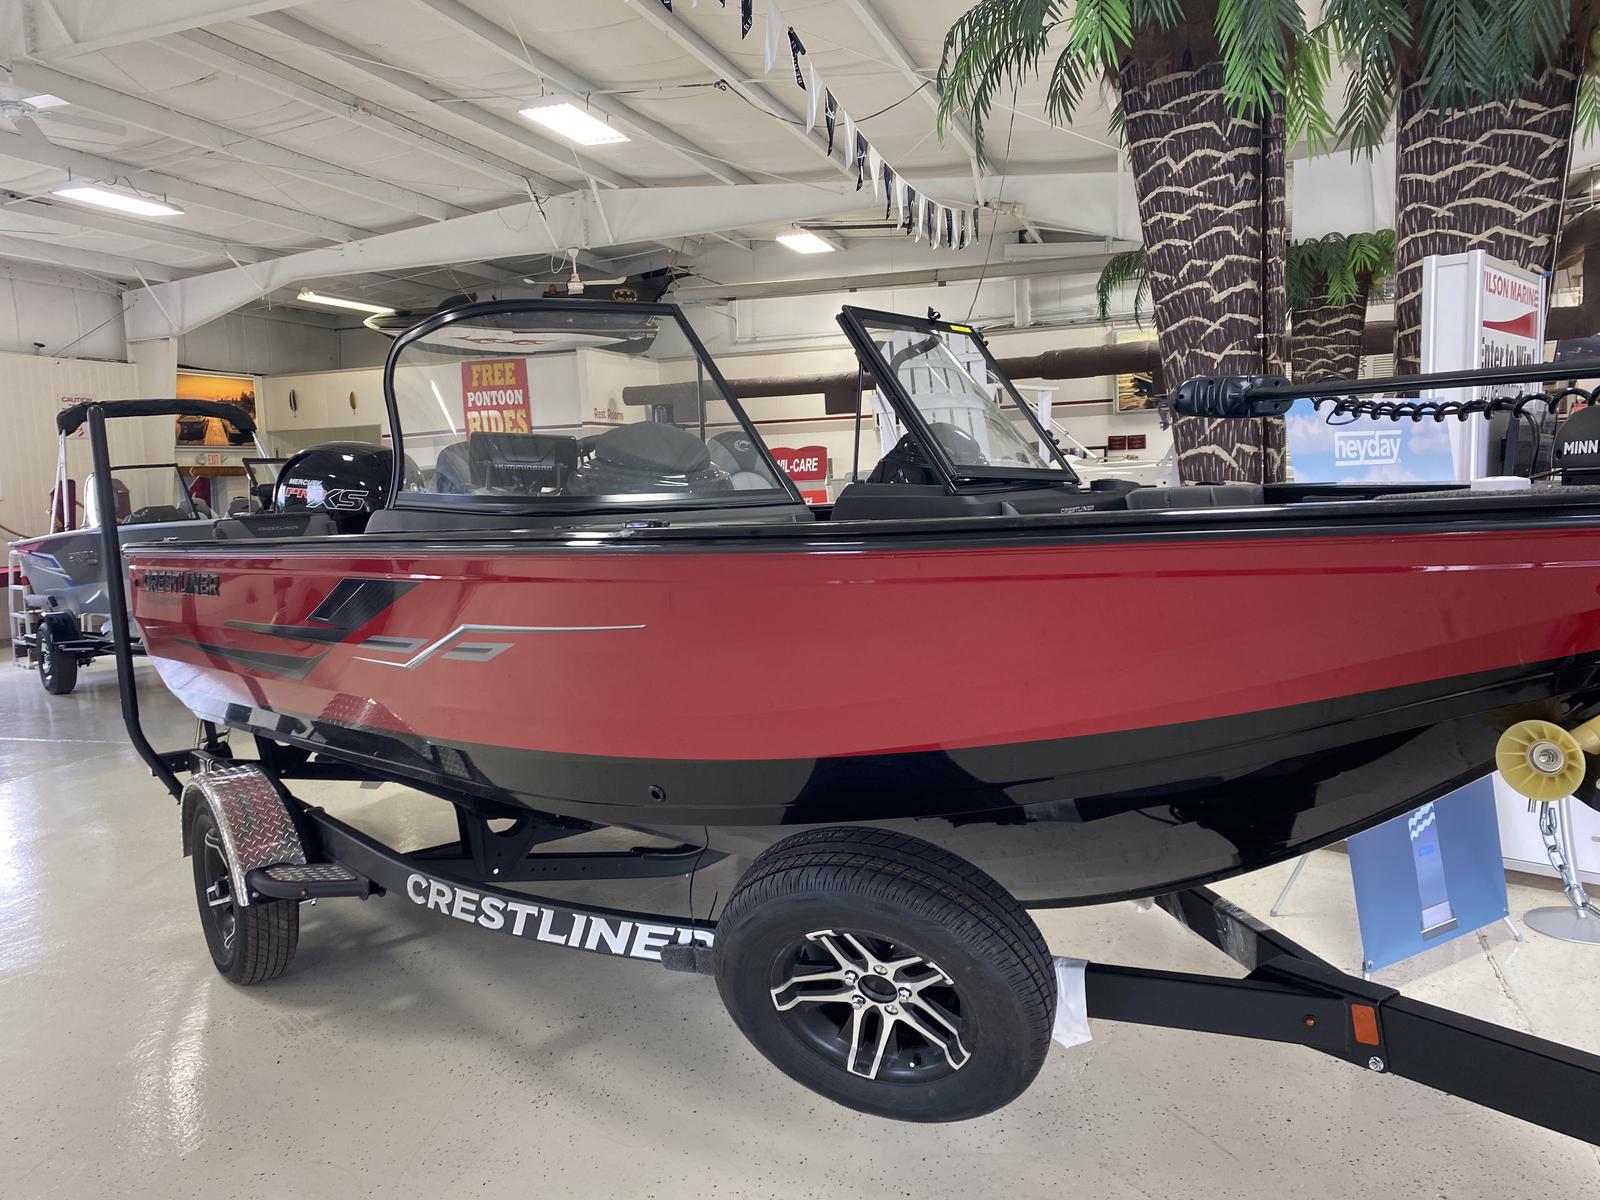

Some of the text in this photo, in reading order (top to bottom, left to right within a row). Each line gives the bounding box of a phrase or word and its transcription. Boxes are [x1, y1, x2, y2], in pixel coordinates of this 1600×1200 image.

[1484, 270, 1538, 308] ILSON MARINE
[1506, 344, 1514, 367] to
[471, 363, 516, 387] FREE
[467, 389, 523, 407] PONTOON
[467, 409, 528, 433] RIDES
[1335, 430, 1402, 466] heyday
[1563, 440, 1599, 455] MINN
[288, 478, 324, 486] MERCURY
[305, 488, 370, 512] XS
